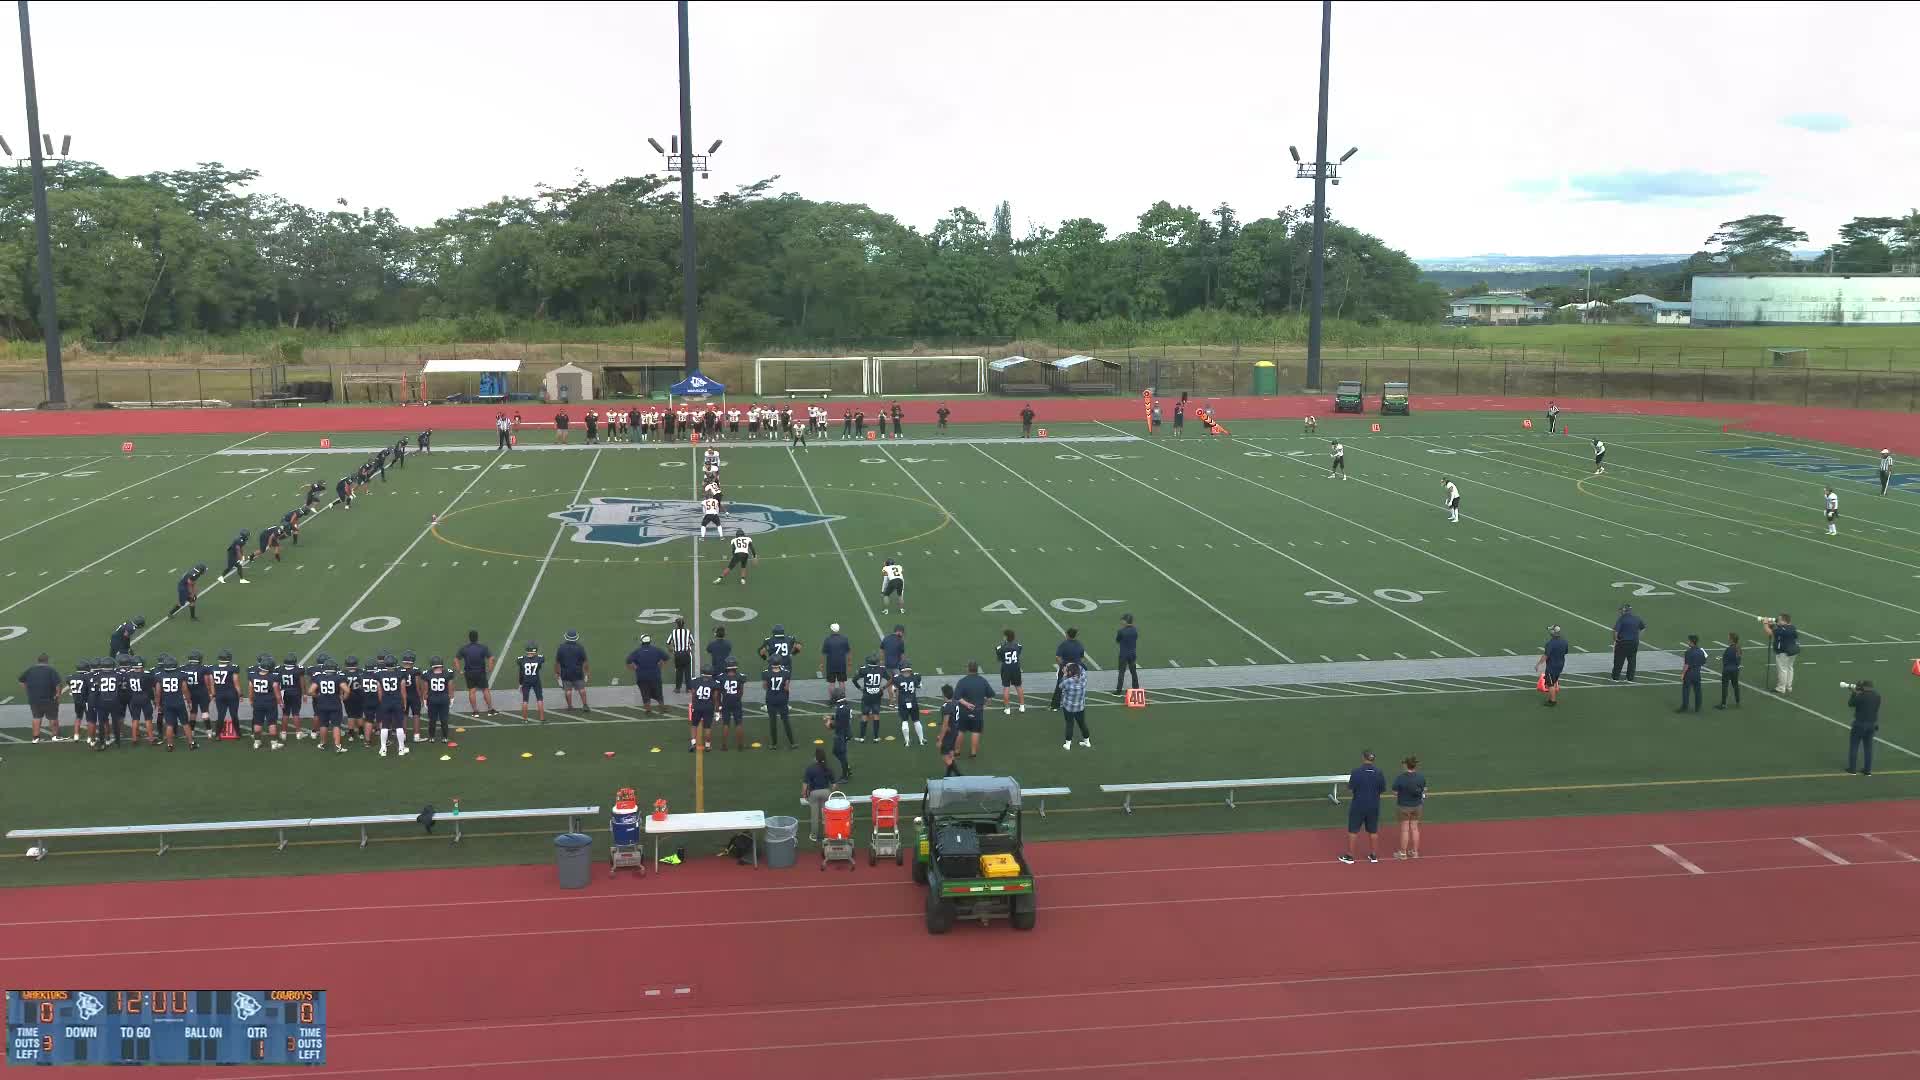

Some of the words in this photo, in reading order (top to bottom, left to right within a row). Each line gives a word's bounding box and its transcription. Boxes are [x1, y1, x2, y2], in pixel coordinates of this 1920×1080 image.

[706, 500, 716, 510] 54
[736, 538, 748, 548] 65
[892, 567, 900, 576] 2
[774, 643, 788, 656] 79
[1005, 651, 1018, 664] 54
[524, 663, 538, 676] 87
[214, 671, 228, 684] 57
[771, 677, 783, 691] 17
[866, 673, 881, 686] 30
[70, 680, 83, 694] 27
[100, 678, 116, 692] 26
[130, 678, 142, 692] 81
[162, 678, 178, 692] 58
[253, 679, 268, 693] 52
[320, 681, 335, 694] 69
[362, 678, 378, 692] 56
[382, 678, 398, 692] 63
[431, 678, 445, 692] 66
[724, 680, 737, 694] 42
[696, 686, 710, 700] 49
[1129, 691, 1143, 705] 40
